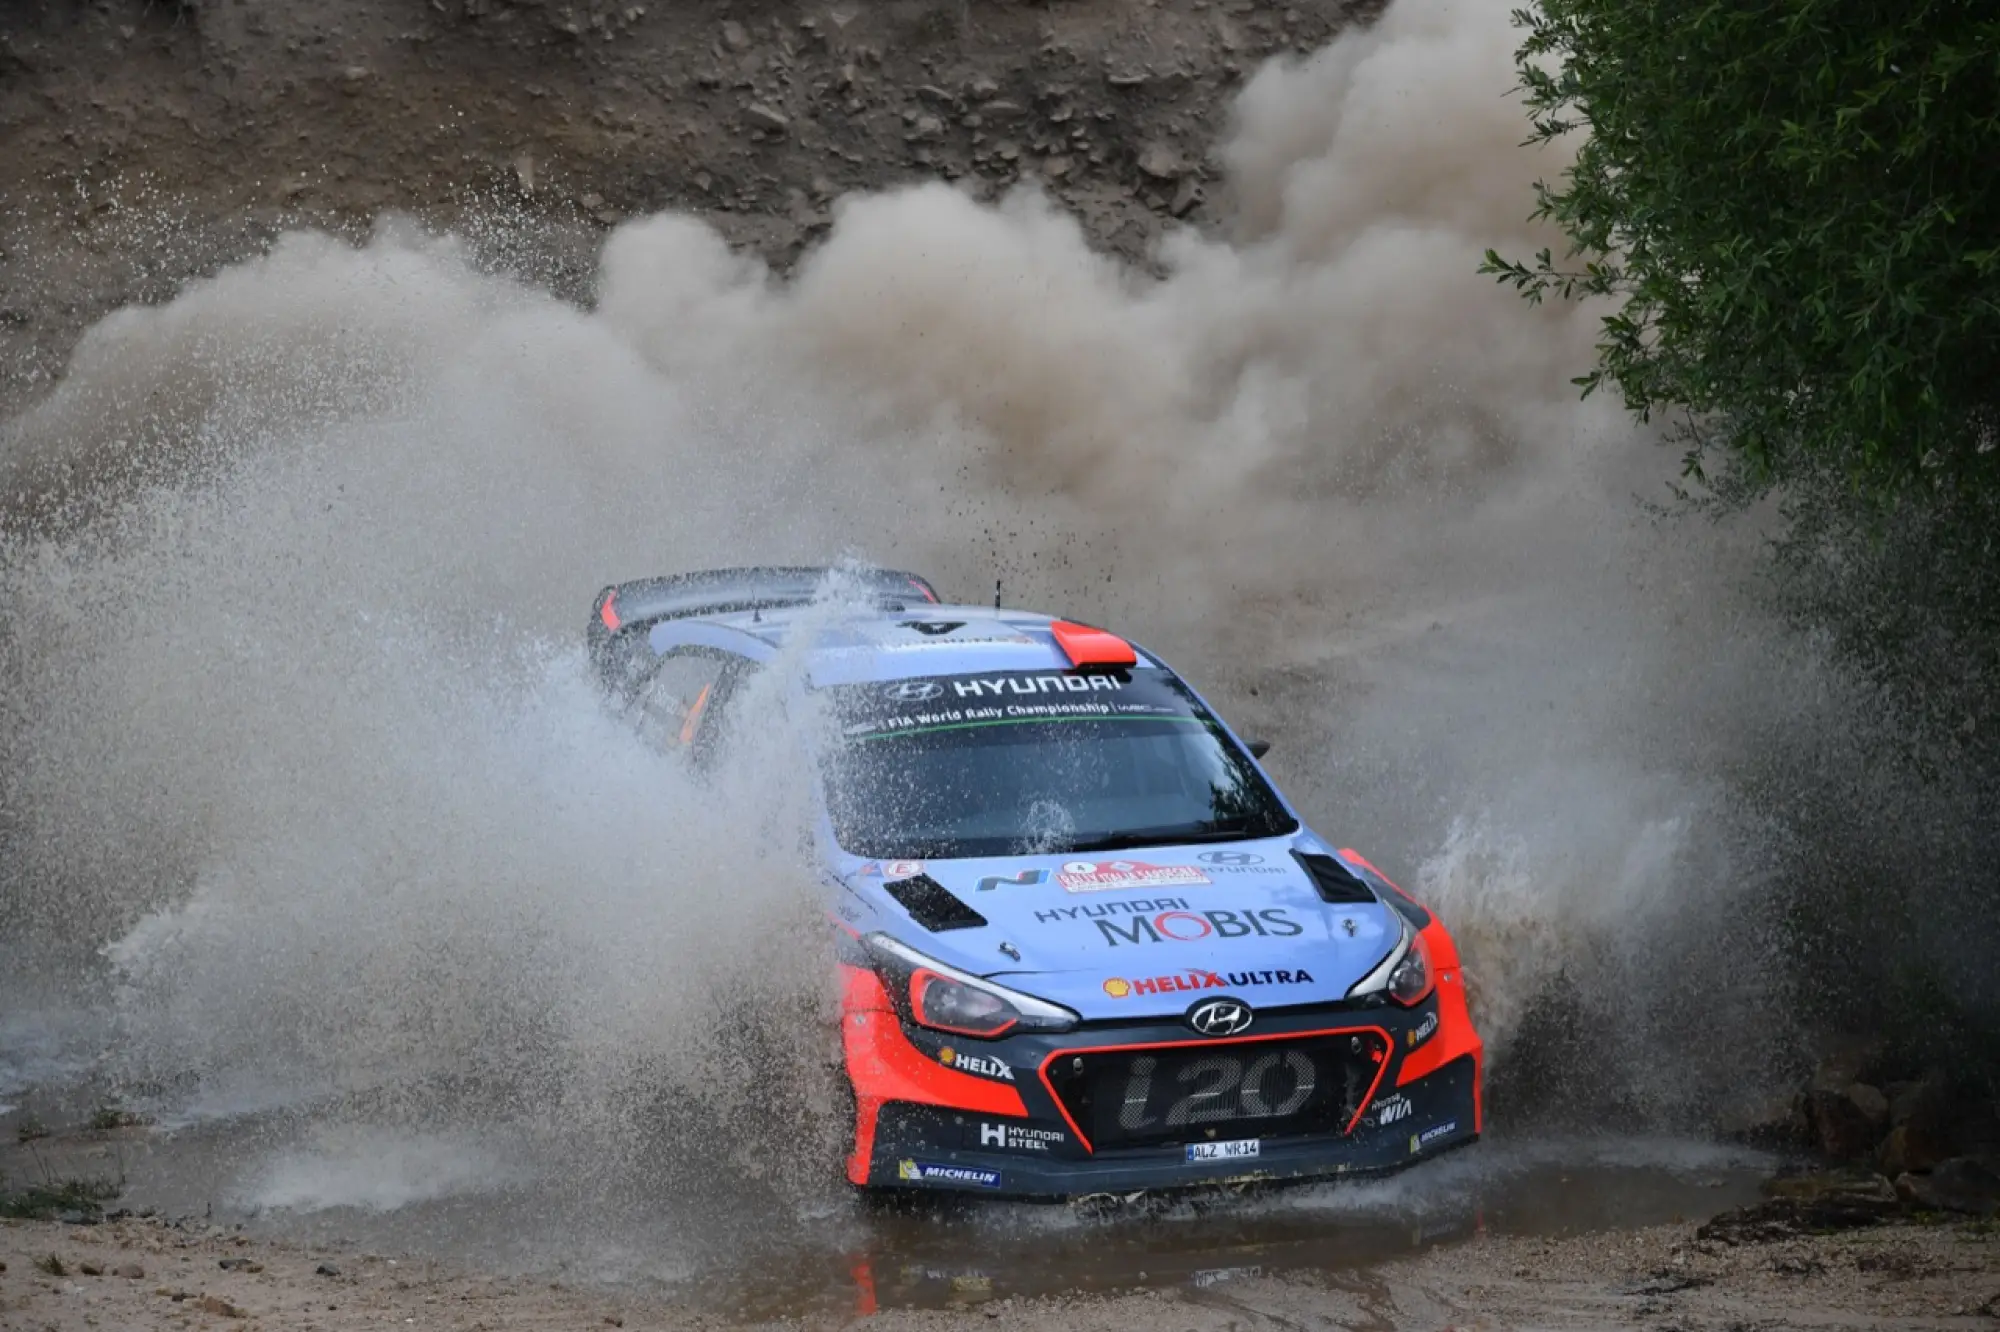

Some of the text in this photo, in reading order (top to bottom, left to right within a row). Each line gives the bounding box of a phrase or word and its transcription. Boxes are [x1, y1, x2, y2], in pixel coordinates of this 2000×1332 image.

[953, 675, 1122, 698] HYUNDAI
[888, 716, 915, 729] FIA
[916, 708, 962, 724] World
[965, 705, 1003, 719] Rally
[1007, 701, 1109, 718] Championship
[1034, 898, 1190, 923] HYUNDAI
[1093, 908, 1304, 947] MOBIS
[1132, 968, 1314, 996] HELIX ULTRA
[955, 1054, 1015, 1080] HELIX
[1380, 1097, 1413, 1125] WIA
[1008, 1127, 1064, 1142] HYUNDAI
[1008, 1139, 1049, 1150] STEEL
[1195, 1144, 1218, 1158] ALZ
[925, 1167, 997, 1183] MICHELIN
